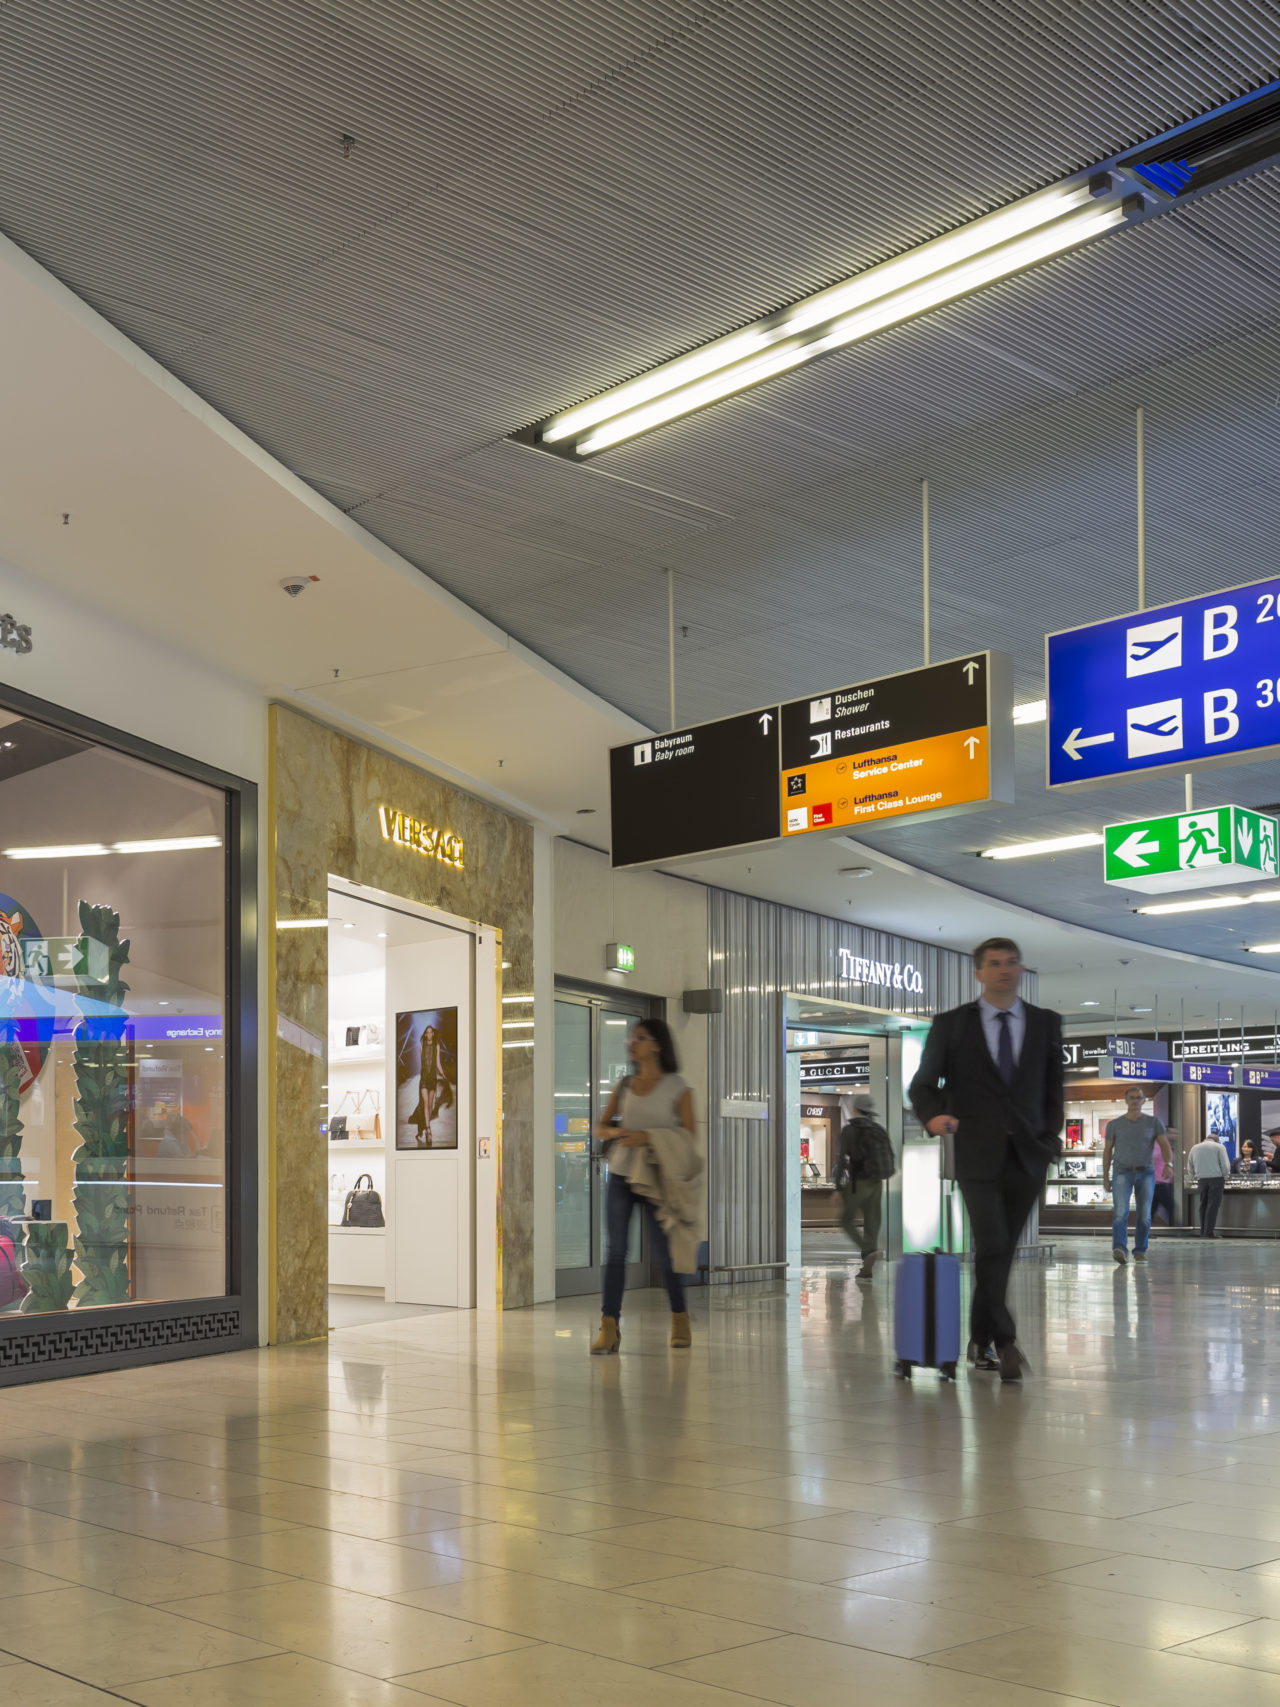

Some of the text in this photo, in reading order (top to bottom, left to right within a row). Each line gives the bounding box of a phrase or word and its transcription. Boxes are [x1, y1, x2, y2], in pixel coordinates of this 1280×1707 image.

[1203, 593, 1280, 661] B 2
[835, 688, 874, 705] Duschen
[835, 702, 870, 718] Shower
[1203, 677, 1280, 744] B 3
[835, 720, 890, 740] Restaurants
[654, 734, 693, 750] Babyraum
[655, 745, 695, 762] Baby room
[853, 753, 898, 770] Lufthansa
[852, 758, 924, 780] Service Center
[854, 789, 899, 805] Lufthansa
[854, 791, 943, 816] First Class Lounge
[1181, 1043, 1250, 1054] BREITLING
[809, 1066, 846, 1076] GUCCI
